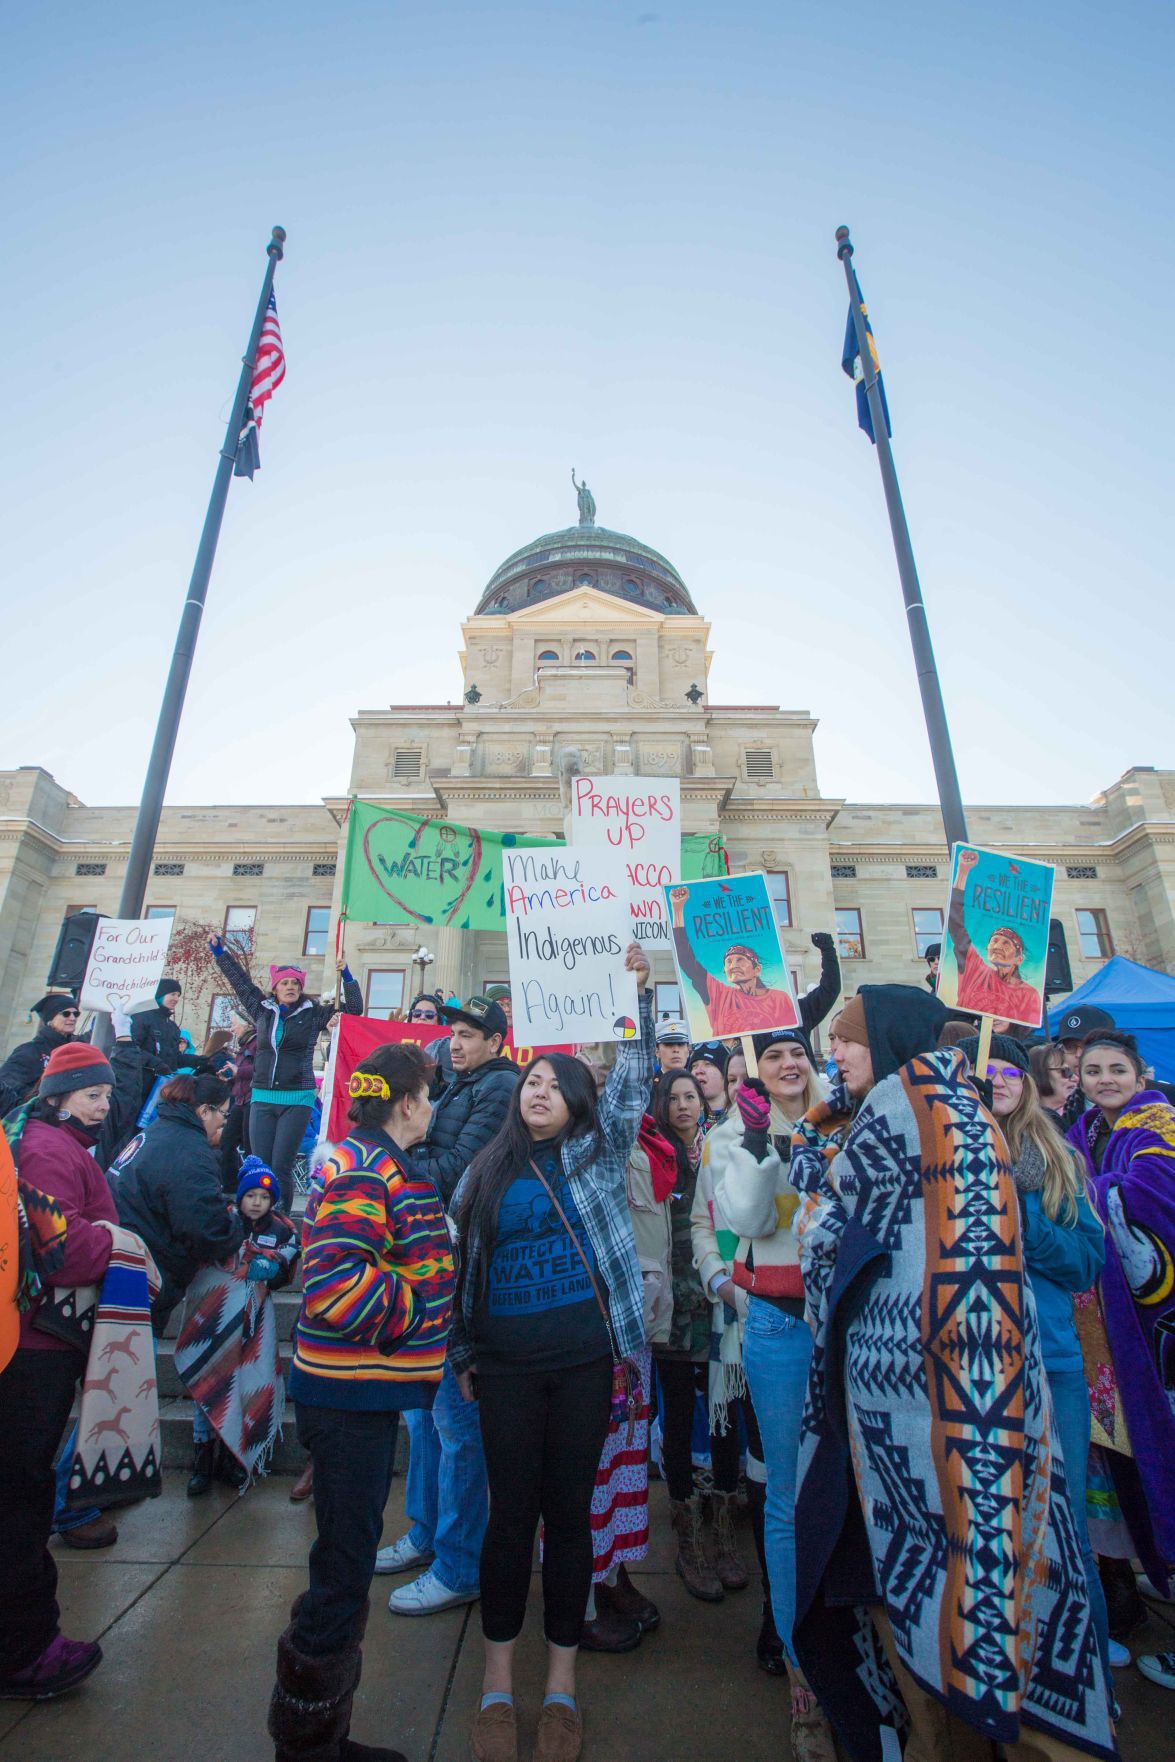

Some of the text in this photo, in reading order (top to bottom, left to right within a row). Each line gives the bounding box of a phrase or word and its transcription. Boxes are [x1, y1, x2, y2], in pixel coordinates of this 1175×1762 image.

[607, 822, 645, 849] UP
[377, 852, 460, 885] WATER
[508, 854, 582, 883] Make
[999, 873, 1029, 893] WE THE
[507, 883, 617, 916] America
[712, 894, 745, 910] WE THE
[972, 883, 1048, 926] RESILIENT
[98, 926, 159, 945] For Our
[692, 905, 771, 940] RESILIENT
[516, 916, 622, 970] Indigenous
[521, 972, 616, 1032] Again!
[492, 1276, 592, 1306] DEFEND THE LAND
